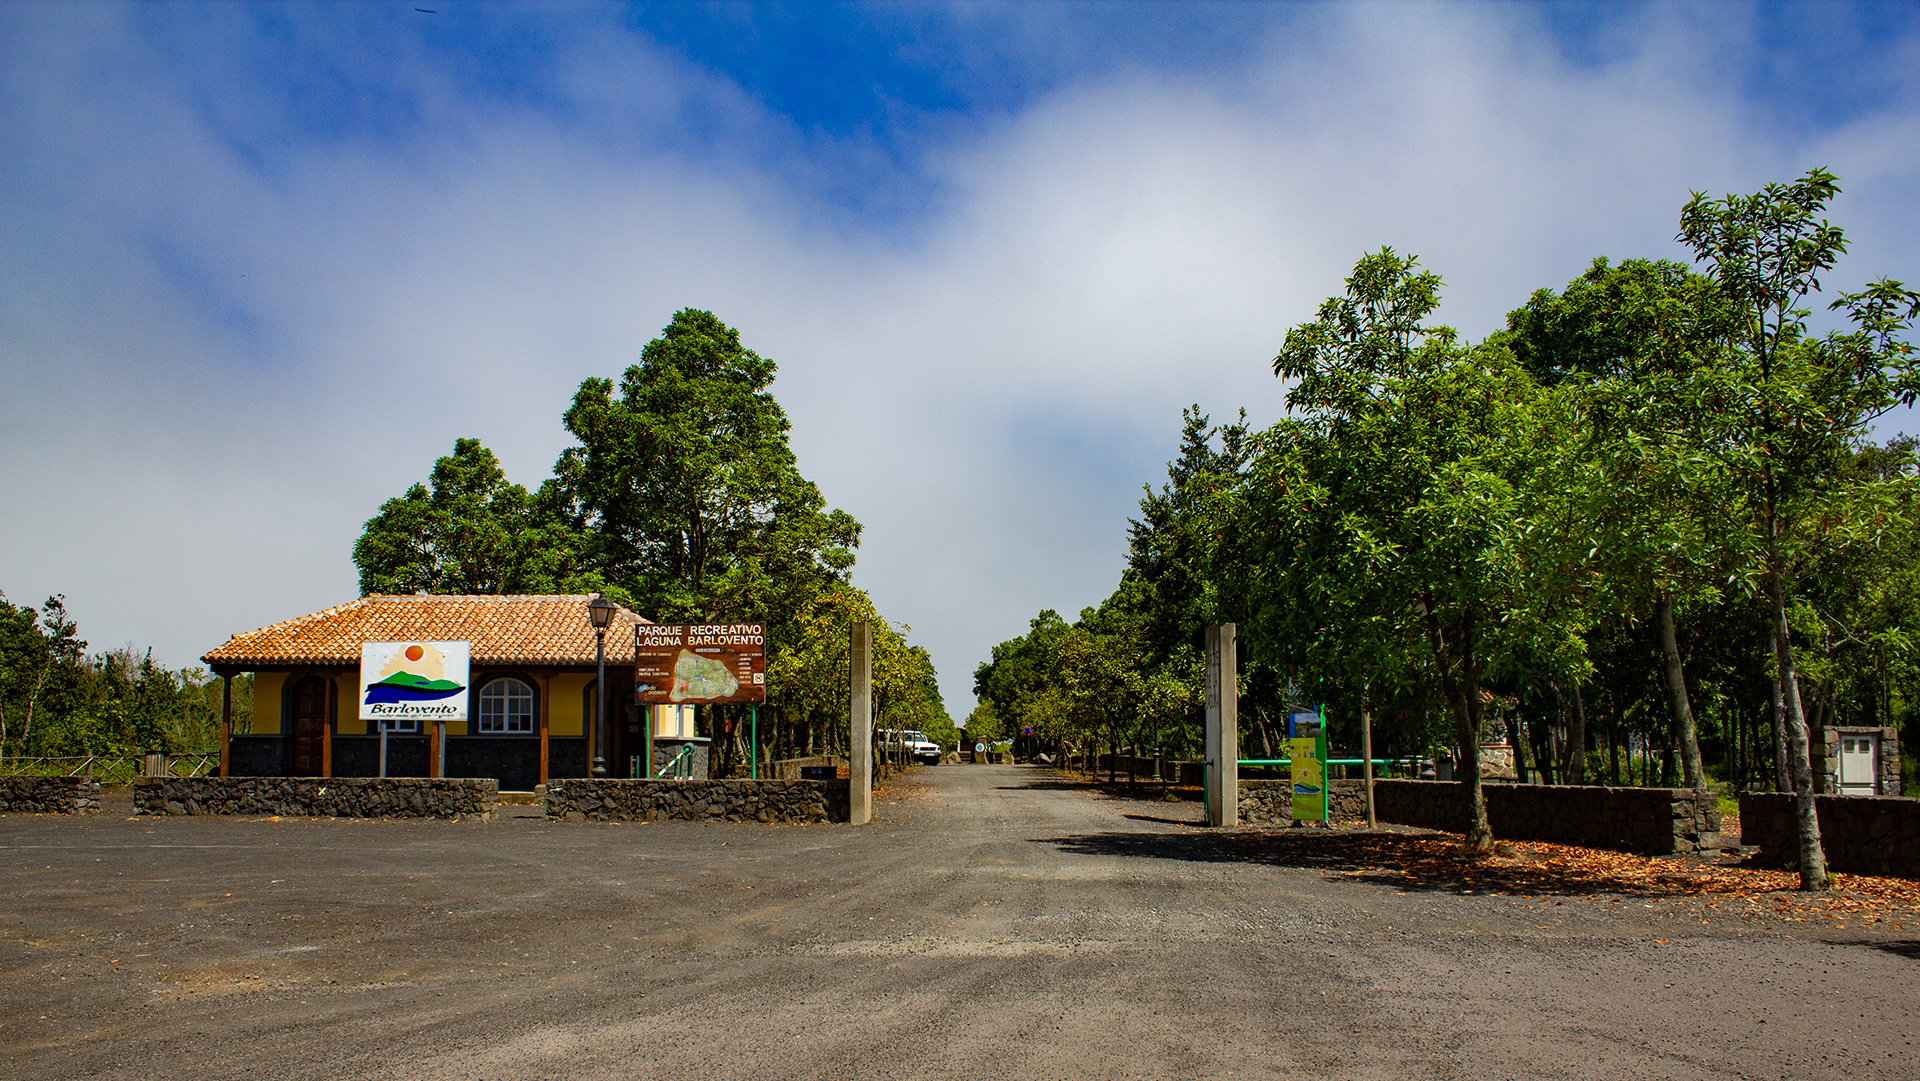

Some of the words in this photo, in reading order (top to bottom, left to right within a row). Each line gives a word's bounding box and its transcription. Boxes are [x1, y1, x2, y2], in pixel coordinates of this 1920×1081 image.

[638, 625, 683, 637] PARQUE
[690, 625, 762, 635] RECREATIVO
[636, 637, 682, 646] LAGUNA
[687, 636, 764, 646] BARLOVENTO
[370, 703, 458, 714] Barlovento
